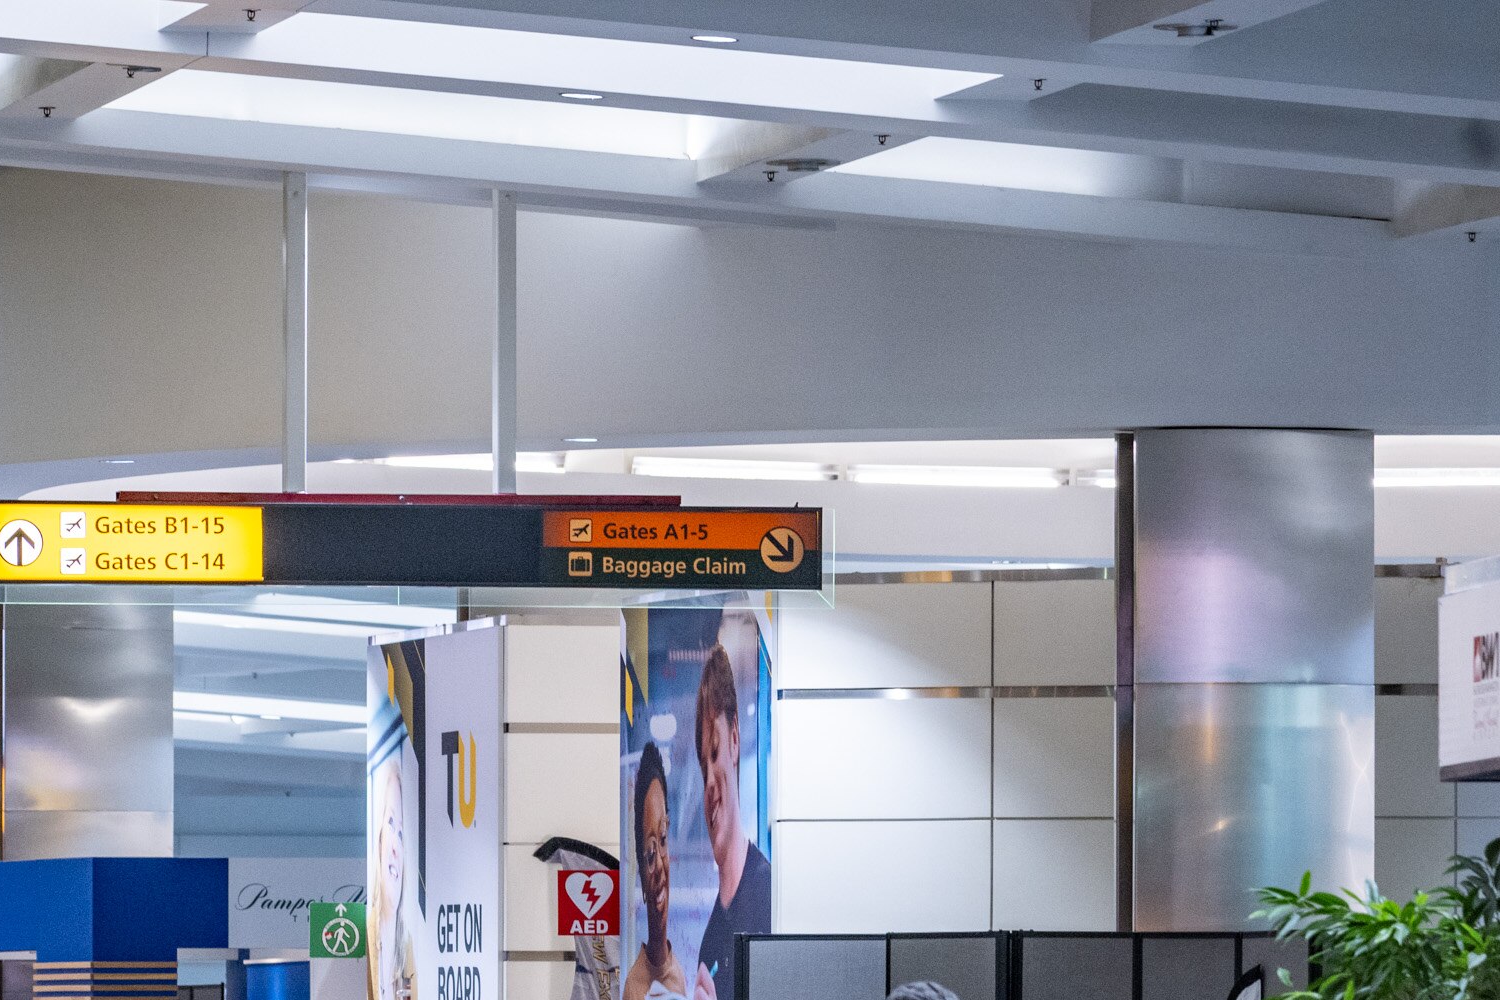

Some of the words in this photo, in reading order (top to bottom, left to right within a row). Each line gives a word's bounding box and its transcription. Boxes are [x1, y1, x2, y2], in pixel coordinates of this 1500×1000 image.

[95, 516, 156, 534] Gates
[165, 516, 225, 534] B1-15
[603, 522, 658, 540] Gates
[664, 523, 709, 540] A1-5
[95, 552, 156, 570] Gates
[164, 552, 226, 570] C1-14
[602, 557, 687, 577] Baggage
[693, 558, 746, 574] Claim
[441, 729, 476, 829] TU
[437, 904, 460, 953] GET
[463, 903, 482, 953] ON
[570, 920, 608, 934] AED
